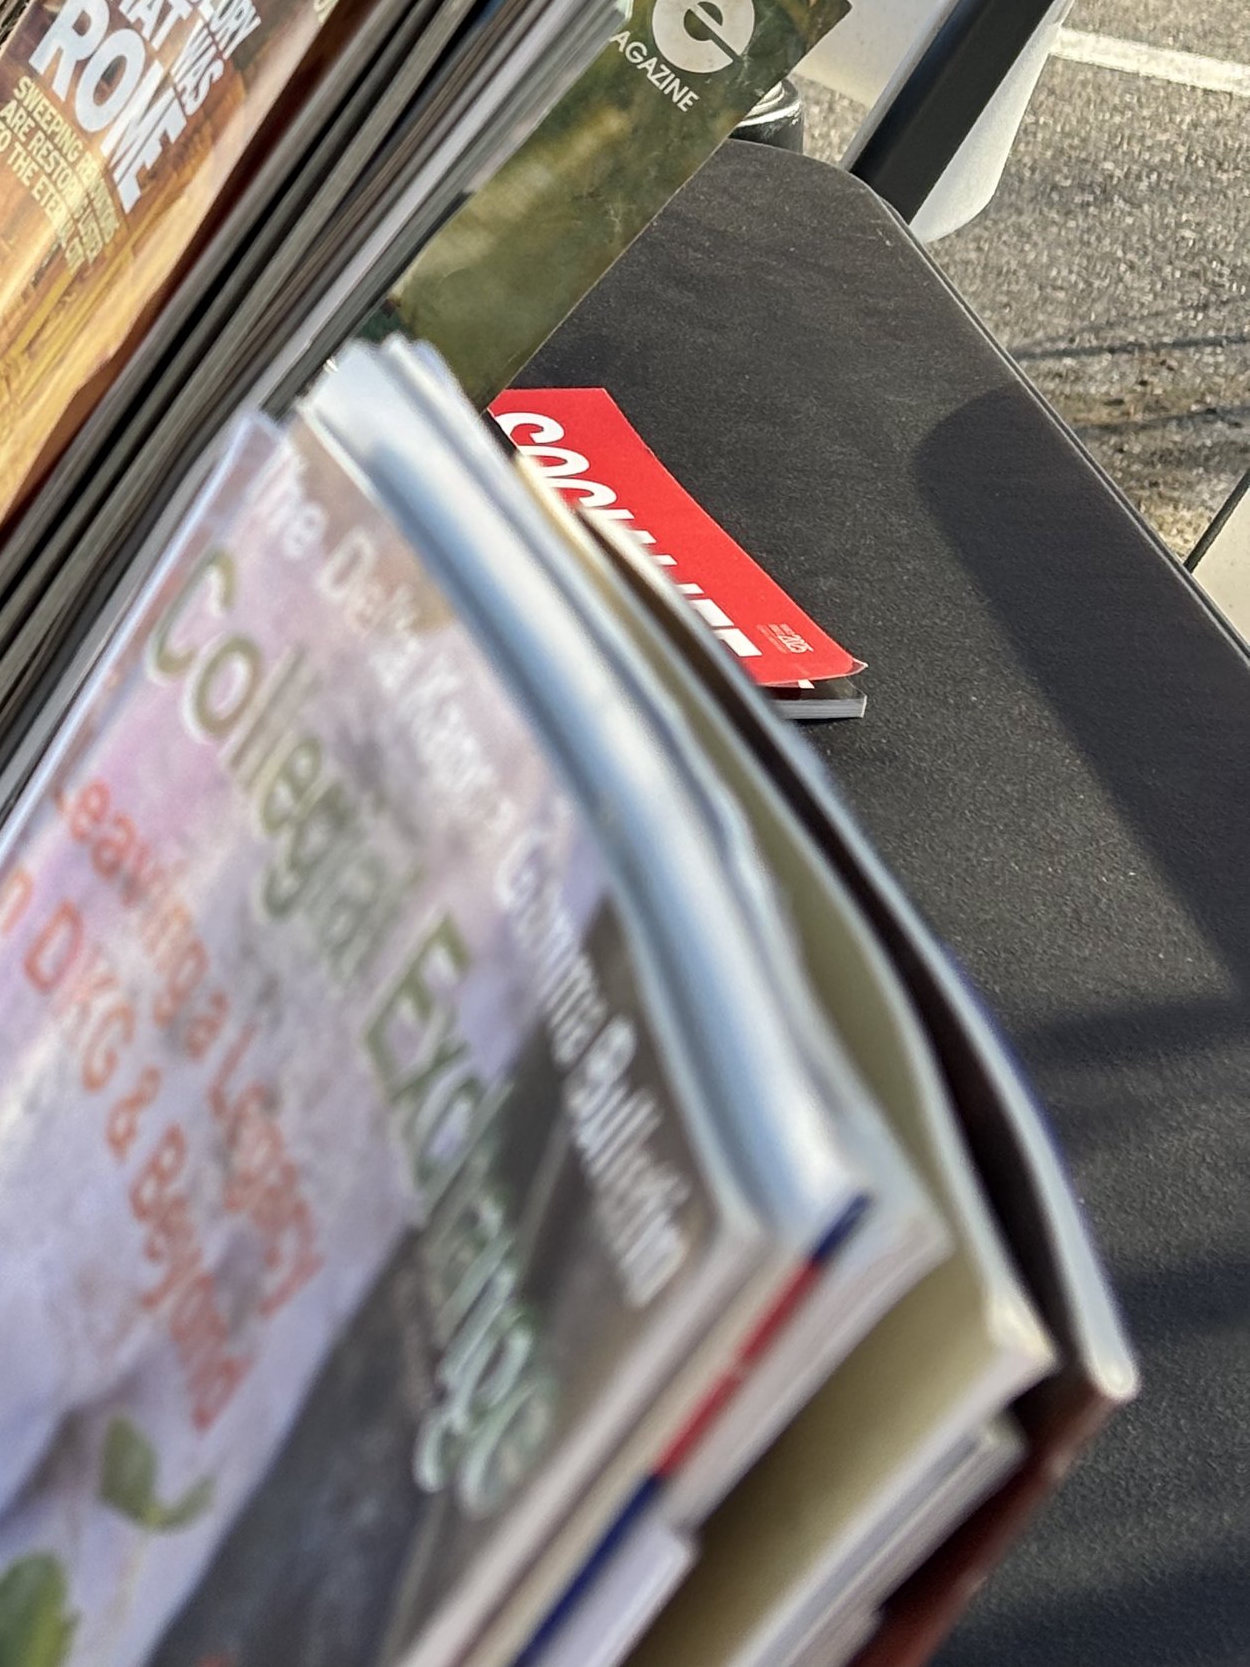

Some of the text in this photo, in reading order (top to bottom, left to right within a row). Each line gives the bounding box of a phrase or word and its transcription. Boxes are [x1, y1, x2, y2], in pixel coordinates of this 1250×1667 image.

[169, 13, 225, 124] WAS
[608, 29, 701, 114] AGAZINE
[13, 75, 85, 162] SWEEPING
[6, 141, 40, 187] THE
